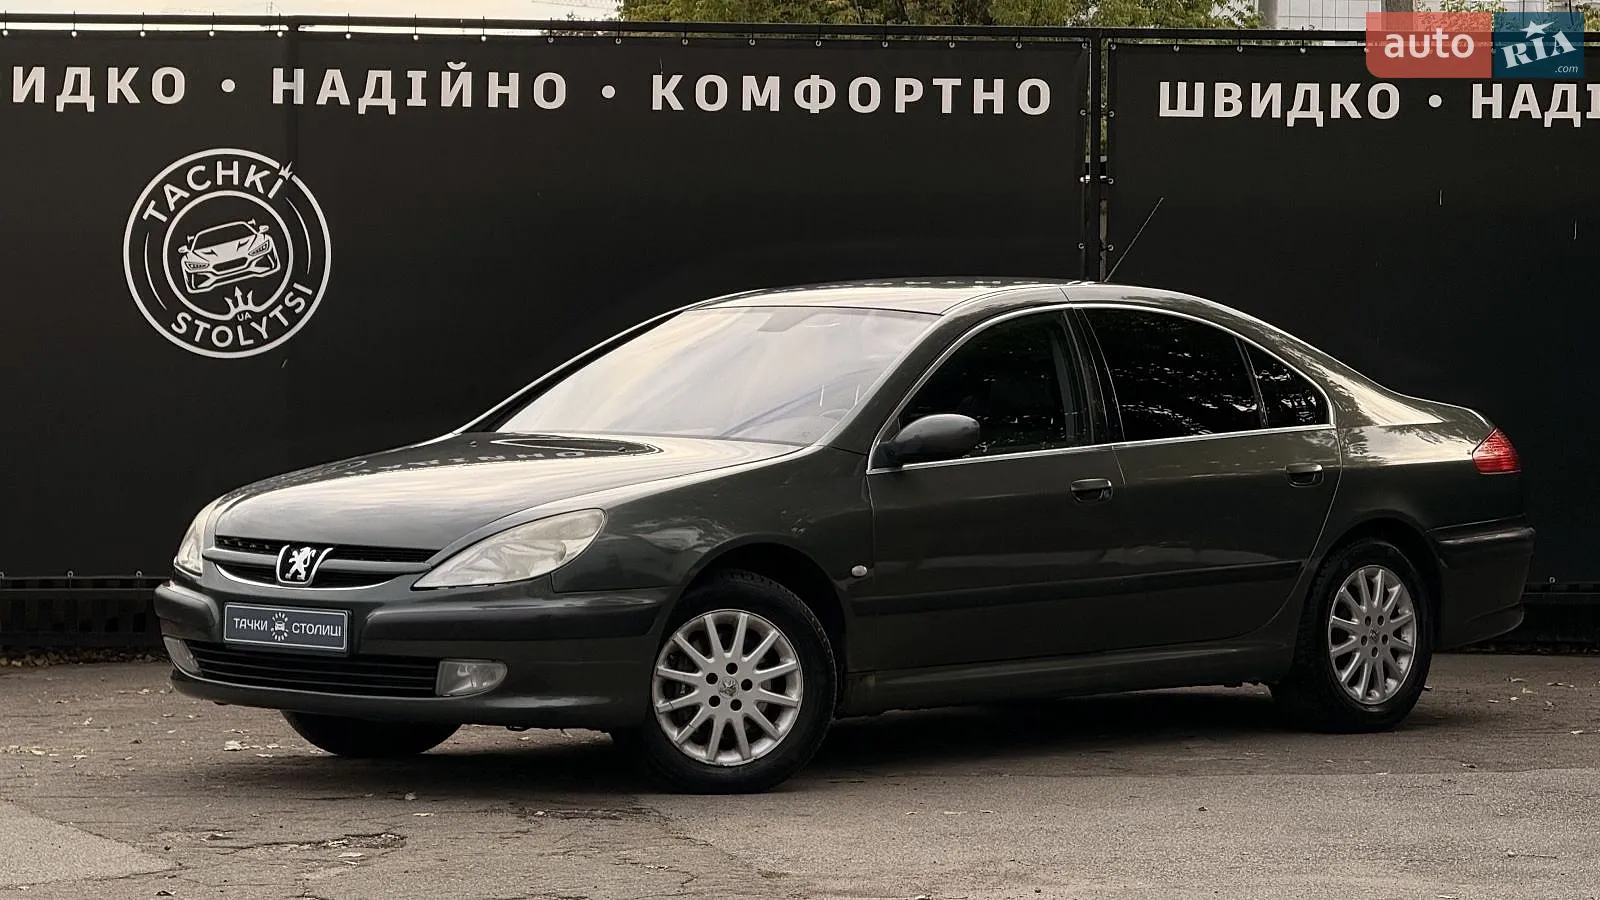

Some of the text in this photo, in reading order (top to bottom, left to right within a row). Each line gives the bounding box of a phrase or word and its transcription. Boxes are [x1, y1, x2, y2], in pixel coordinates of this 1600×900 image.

[12, 61, 1052, 116] ИДКО НАДІЙНО КОМФОРТНО
[1159, 81, 1401, 128] ШВИДКО
[142, 160, 284, 224] TACHKI
[171, 282, 314, 348] STOLYTSI
[237, 312, 253, 322] UA
[233, 617, 342, 637] ТАЧКИ СТОЛИЦІ
